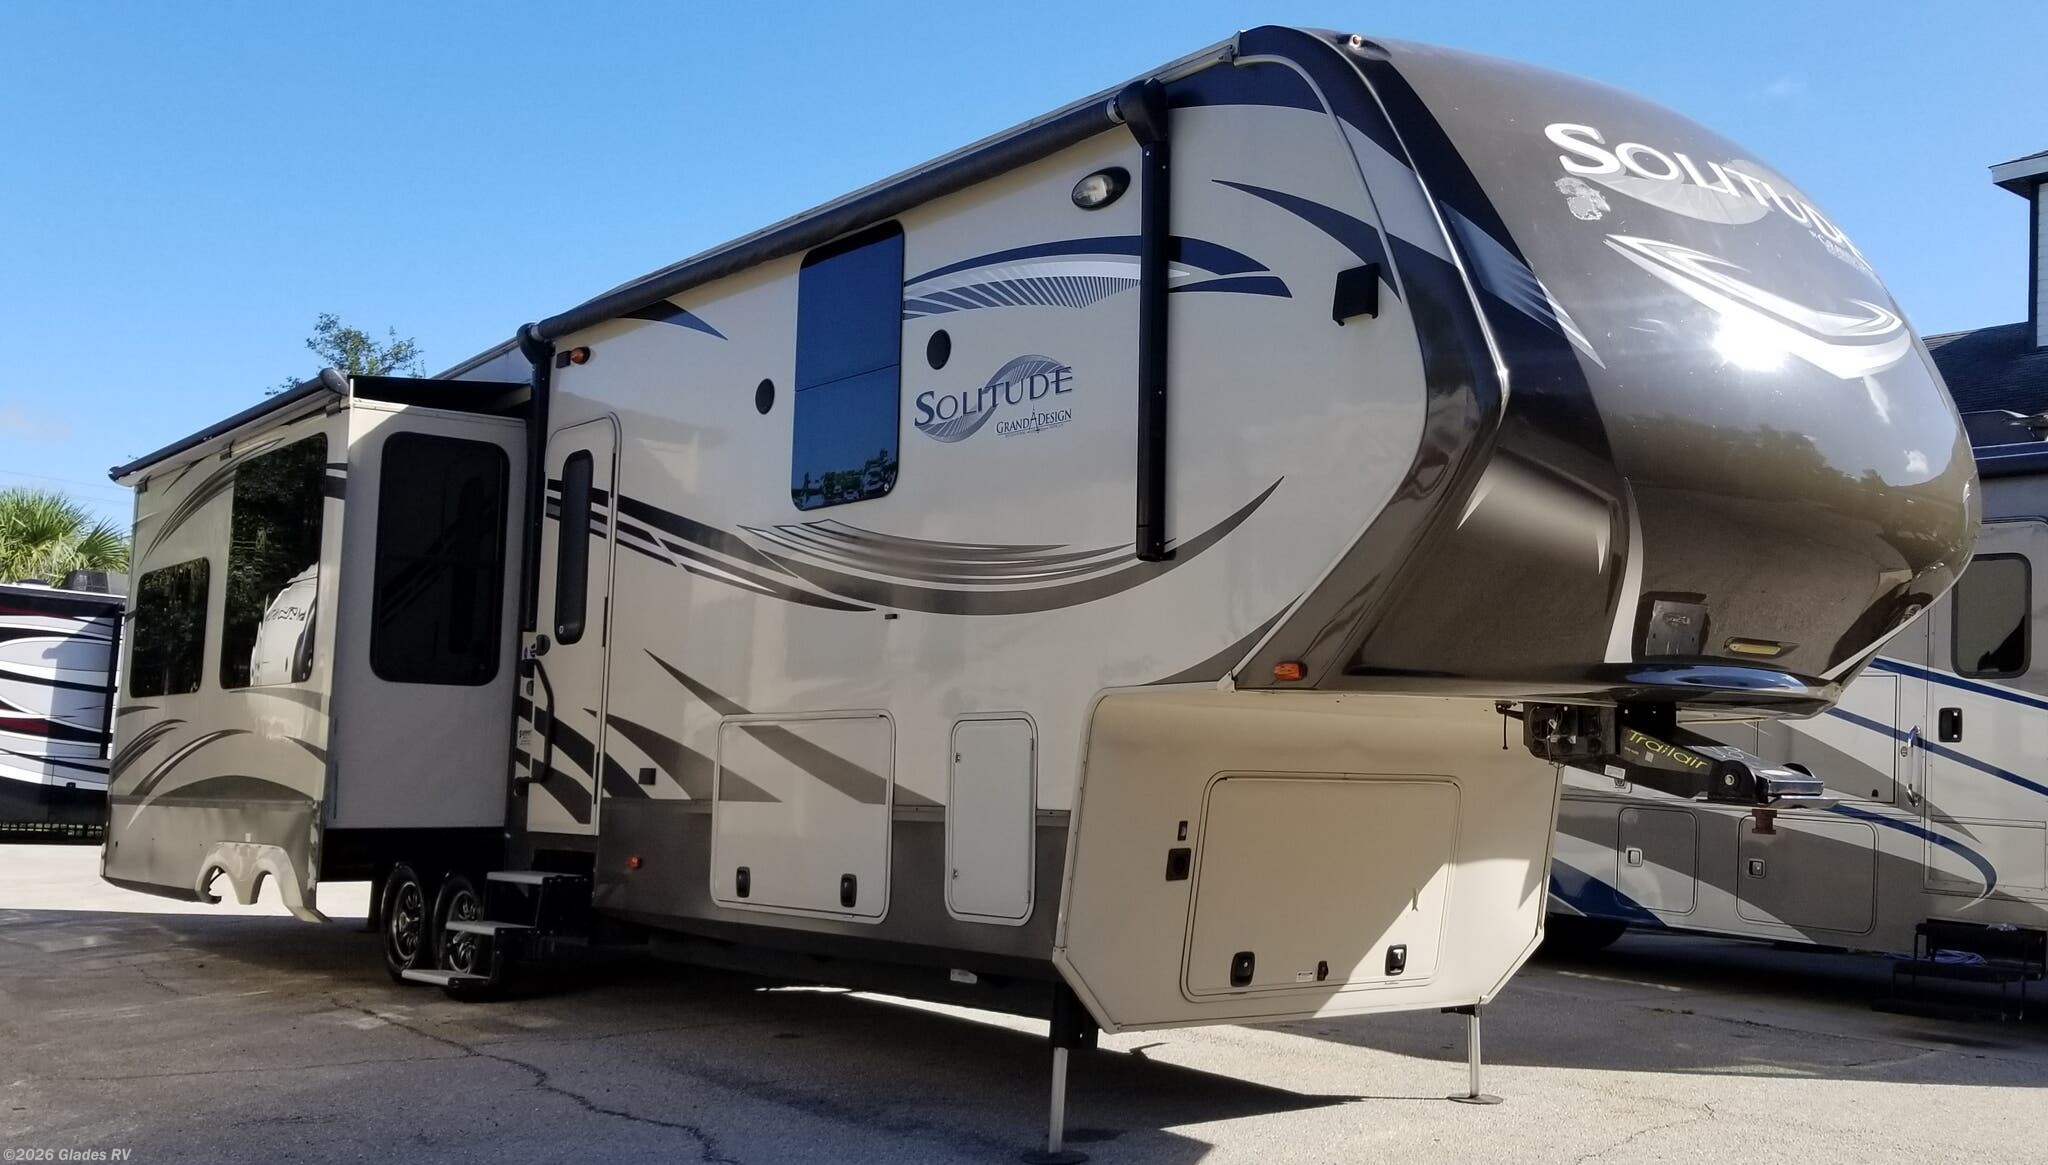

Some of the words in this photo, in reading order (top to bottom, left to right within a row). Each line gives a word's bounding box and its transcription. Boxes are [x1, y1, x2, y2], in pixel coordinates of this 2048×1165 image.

[914, 366, 1073, 427] SOLITUDE
[996, 417, 1030, 434] GRAND
[1038, 408, 1073, 426] DESIGN
[1629, 730, 1708, 769] Trailair
